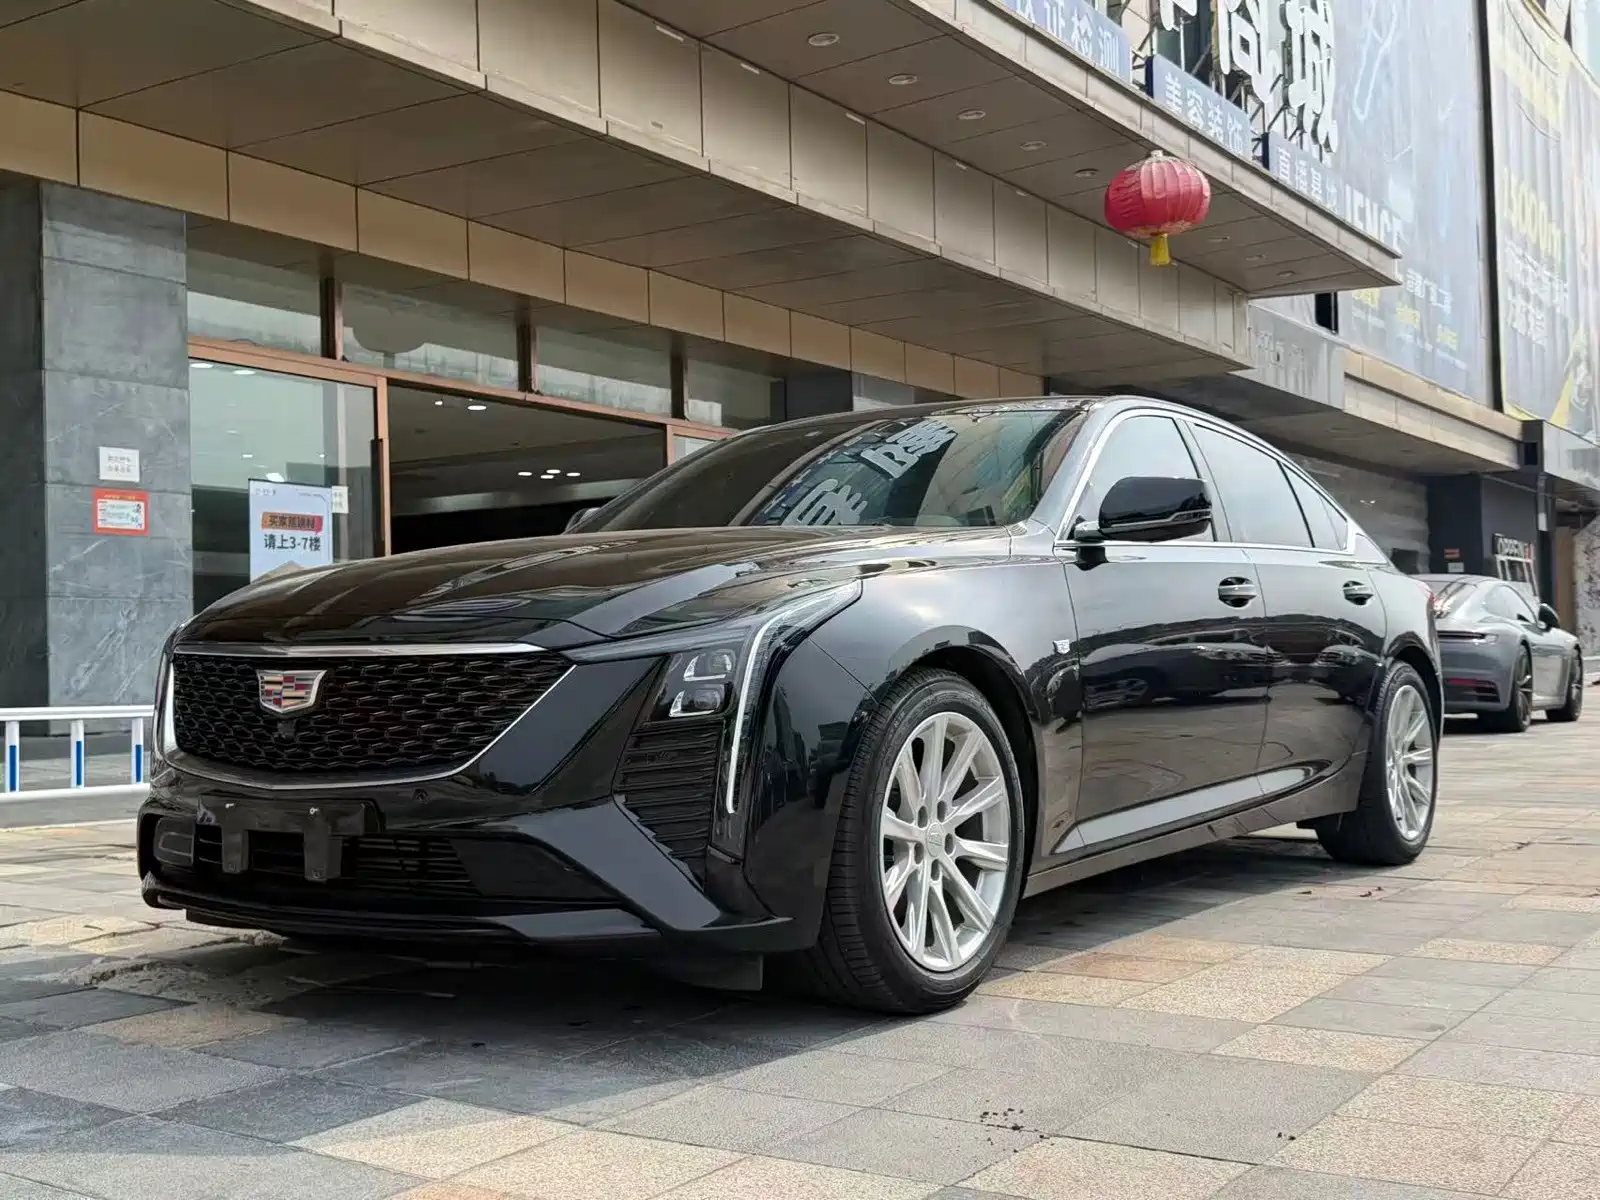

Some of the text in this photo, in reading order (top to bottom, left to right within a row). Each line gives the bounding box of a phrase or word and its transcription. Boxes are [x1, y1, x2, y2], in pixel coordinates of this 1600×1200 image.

[1164, 72, 1246, 155] 美容装饰
[263, 533, 321, 552] 请上3-7楼
